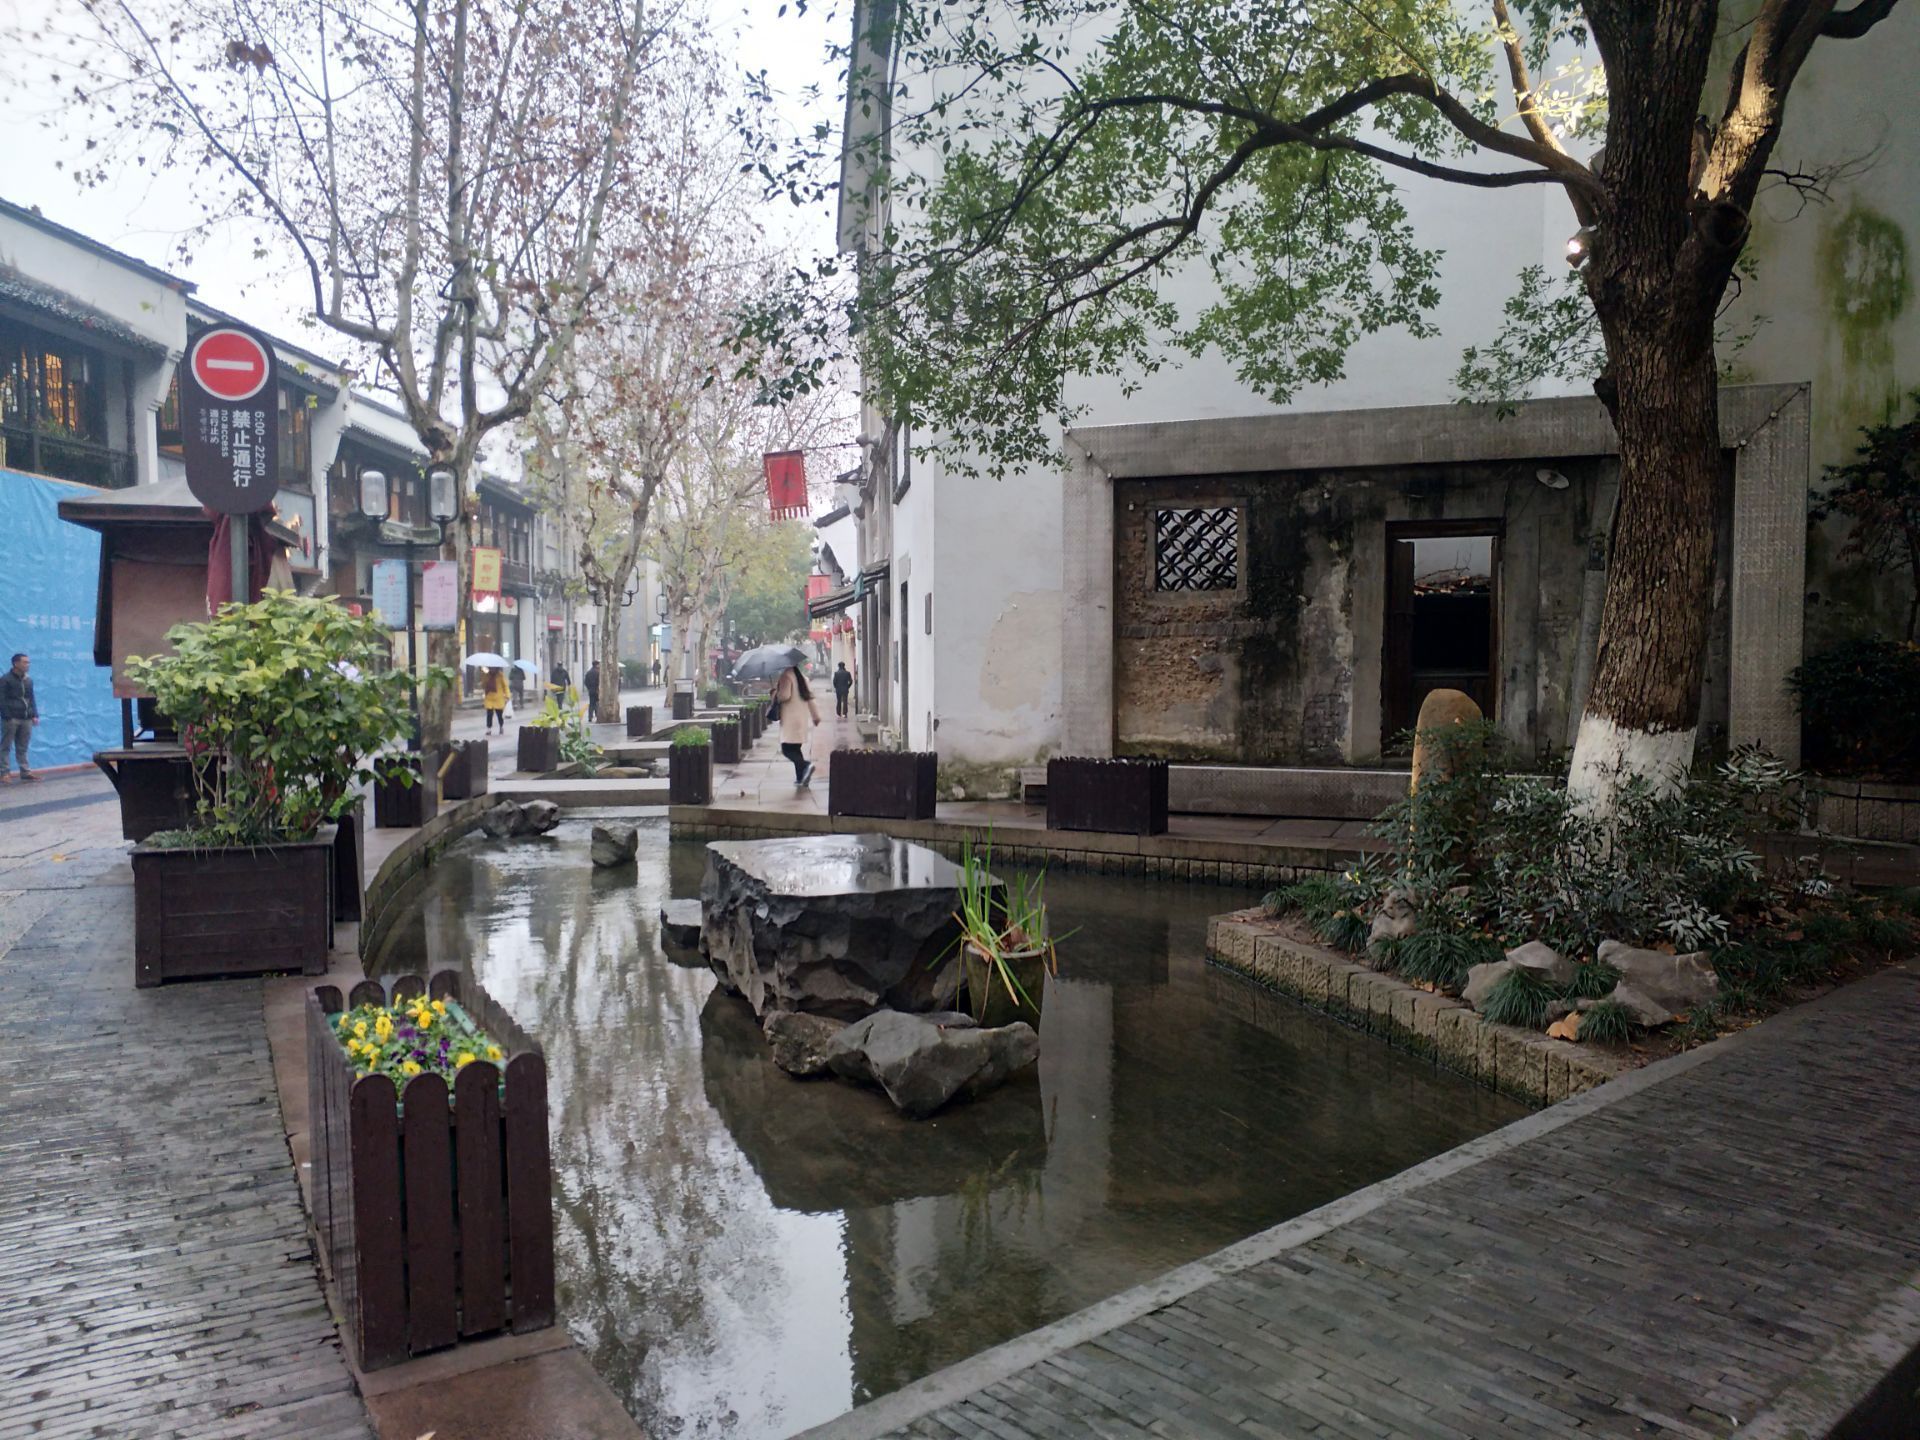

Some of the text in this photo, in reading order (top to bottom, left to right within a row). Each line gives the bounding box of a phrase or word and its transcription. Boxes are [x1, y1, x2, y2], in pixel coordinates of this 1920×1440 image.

[221, 409, 229, 457] no access
[232, 409, 252, 487] 禁止通行
